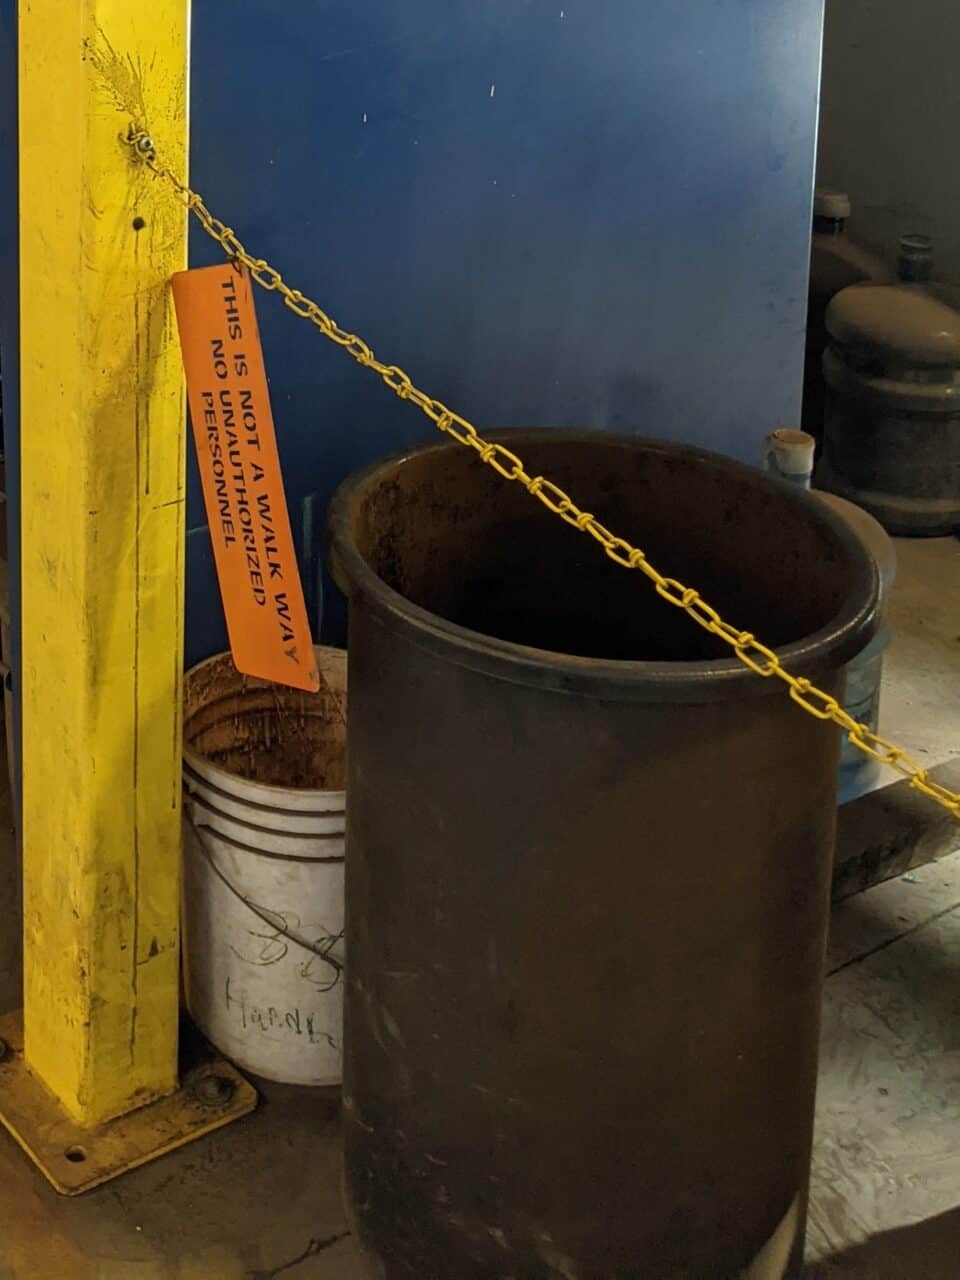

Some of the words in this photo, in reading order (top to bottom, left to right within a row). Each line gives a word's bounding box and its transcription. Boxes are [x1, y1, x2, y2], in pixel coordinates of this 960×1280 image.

[222, 277, 242, 340] THIS
[212, 339, 228, 379] NO
[234, 354, 249, 377] IS
[239, 390, 262, 451] NOT
[201, 392, 236, 548] PERSONNEL
[219, 390, 267, 606] UNAUTHORIZED
[251, 462, 265, 483] A
[257, 493, 283, 579] WALK
[275, 593, 300, 664] WAY
